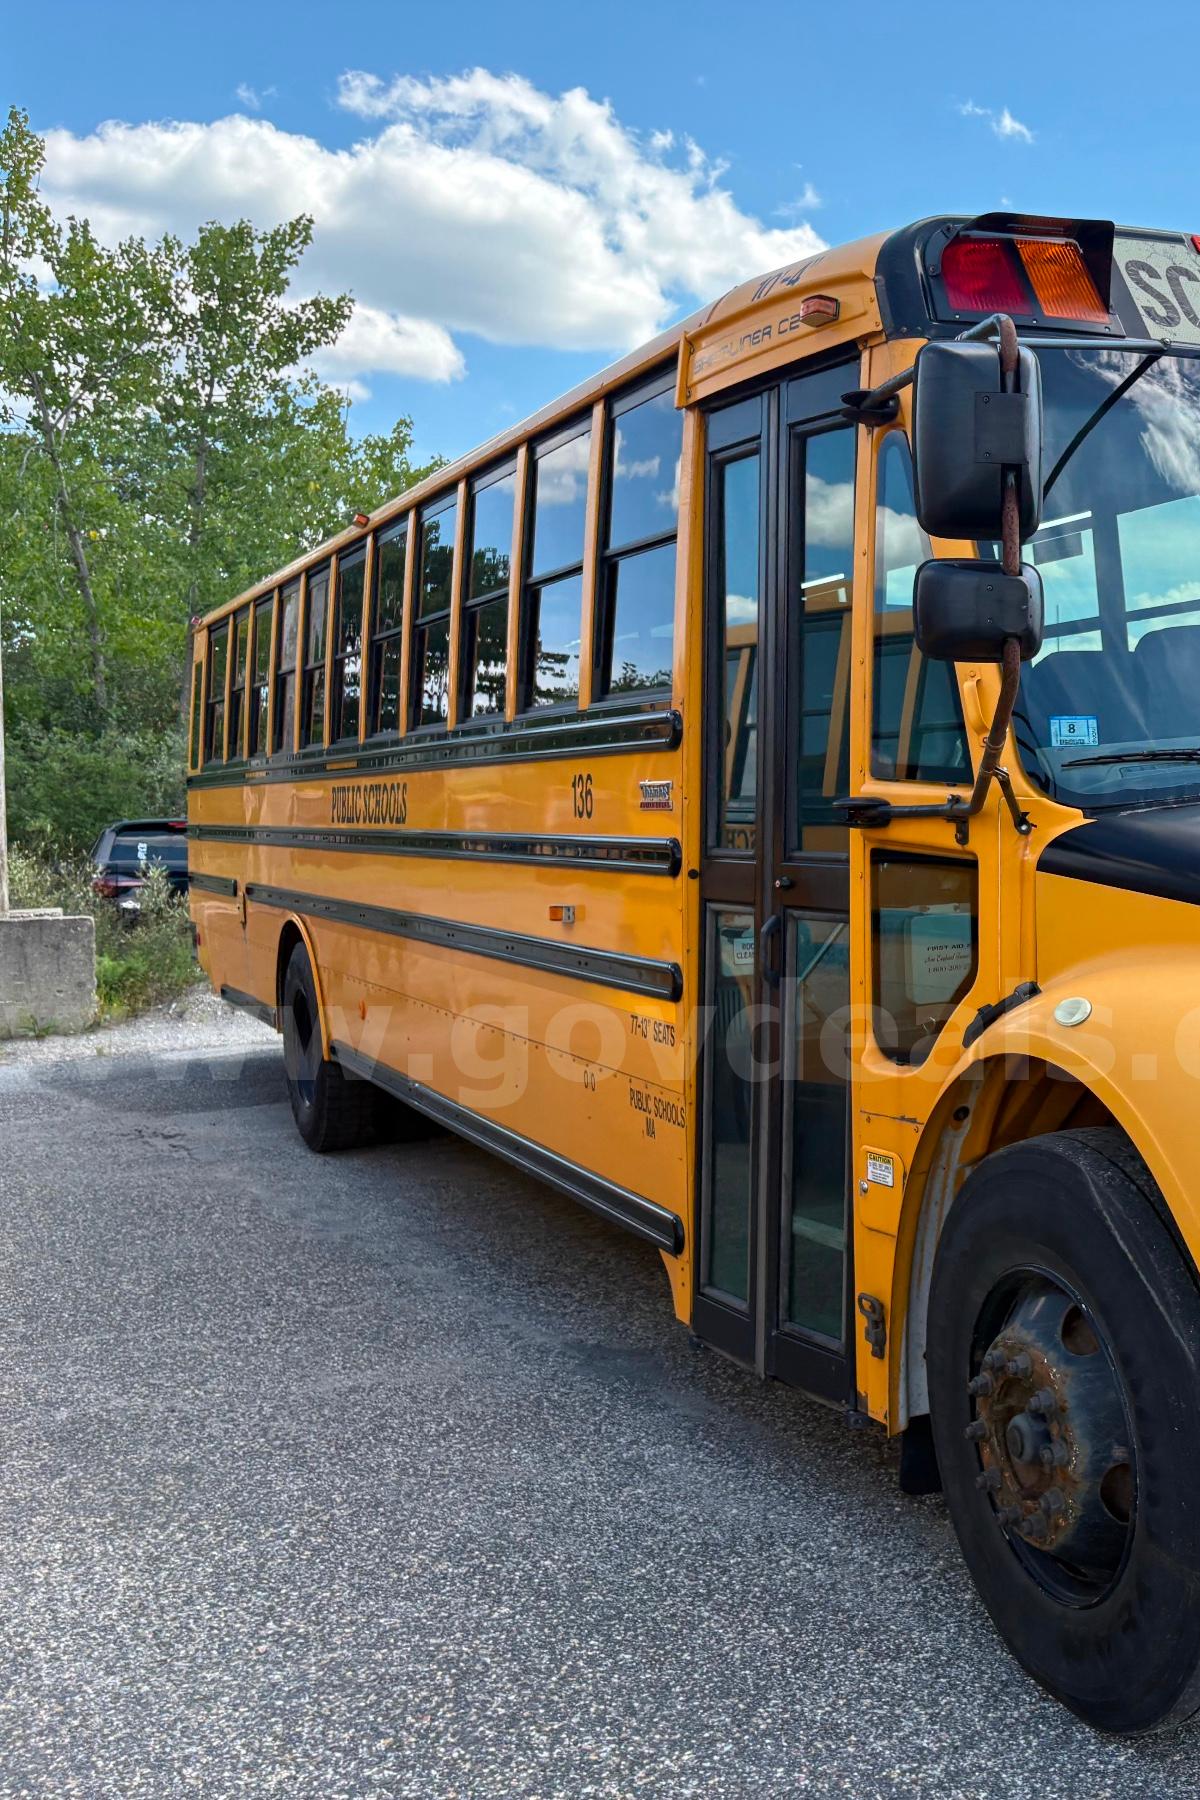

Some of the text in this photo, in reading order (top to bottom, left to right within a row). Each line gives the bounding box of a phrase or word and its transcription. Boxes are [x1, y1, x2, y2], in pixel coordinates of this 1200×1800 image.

[1068, 723, 1076, 734] 8
[331, 782, 408, 825] PUBLIC SCHOOLS
[572, 773, 594, 820] 136
[653, 1020, 675, 1048] SEATS
[629, 1087, 686, 1129] PUBLIC SCHOOLS
[645, 1115, 656, 1139] MA
